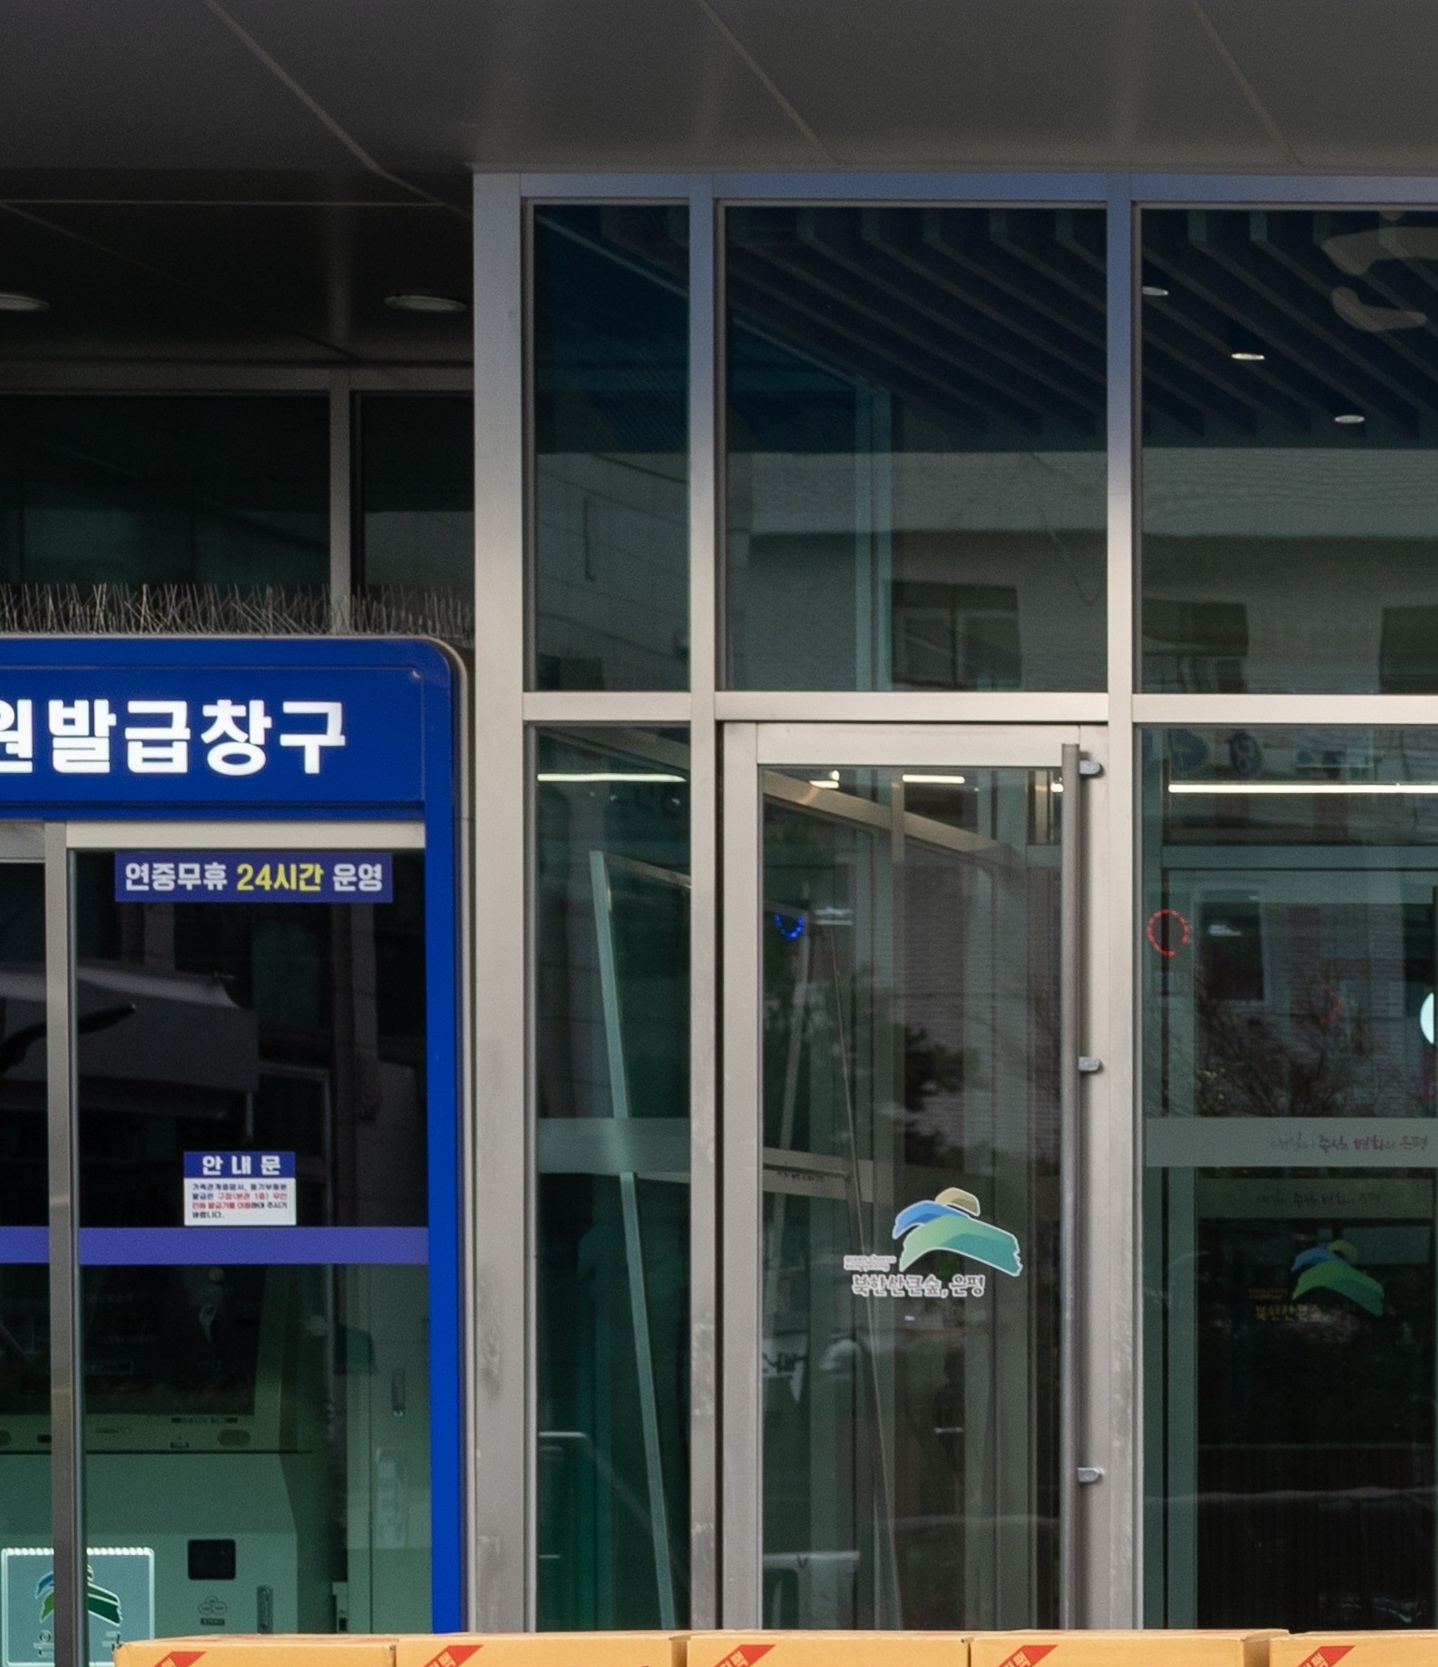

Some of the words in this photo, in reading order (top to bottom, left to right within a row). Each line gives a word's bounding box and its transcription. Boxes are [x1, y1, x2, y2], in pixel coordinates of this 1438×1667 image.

[125, 862, 228, 891] 연중무휴
[236, 863, 324, 891] 24시간
[332, 863, 383, 892] 운영
[1398, 1134, 1429, 1151] 은평
[202, 1155, 281, 1176] 안내문
[852, 1274, 949, 1298] 북한산큰숲,
[950, 1274, 985, 1297] 은평
